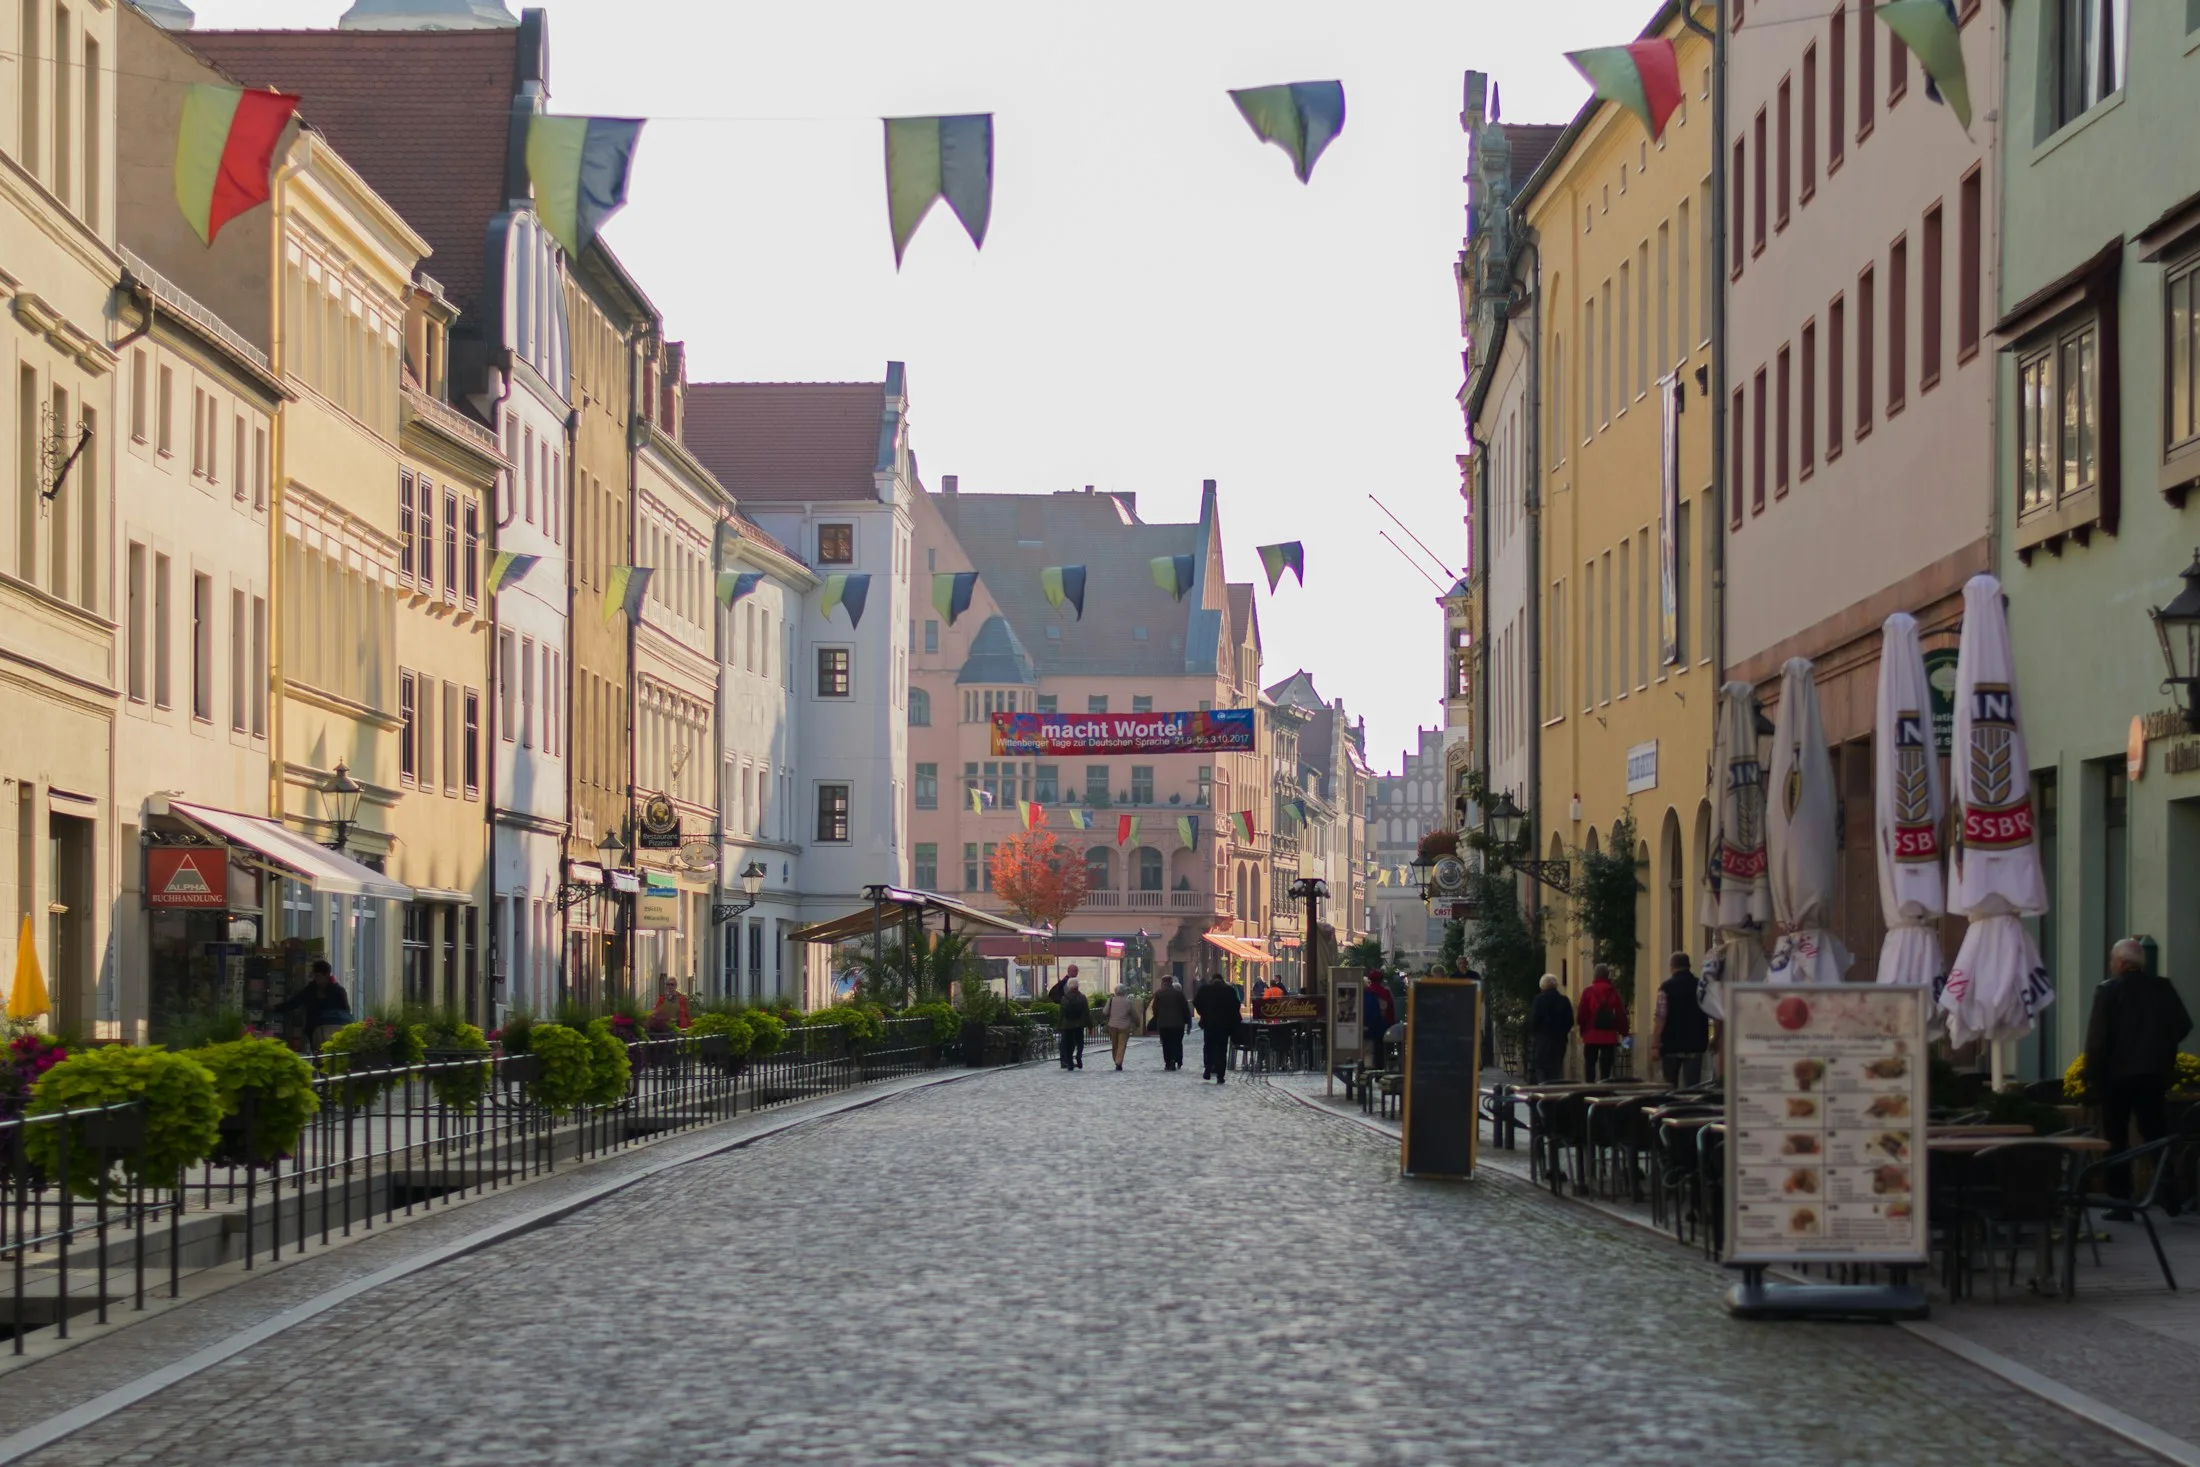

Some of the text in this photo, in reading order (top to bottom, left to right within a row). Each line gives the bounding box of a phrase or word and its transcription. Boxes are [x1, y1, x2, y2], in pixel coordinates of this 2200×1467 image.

[1041, 720, 1183, 738] macht Worte!
[996, 738, 1049, 748] Wittenberger
[1052, 738, 1071, 748] Tage
[1089, 738, 1133, 747] Deutschen
[1135, 737, 1170, 748] Sprache
[1196, 735, 1209, 744] bis
[1210, 733, 1250, 744] 3.10.2017
[642, 833, 678, 841] Restaurant
[168, 883, 207, 891] ALPHA
[152, 894, 223, 903] BUCHHANDLUNG
